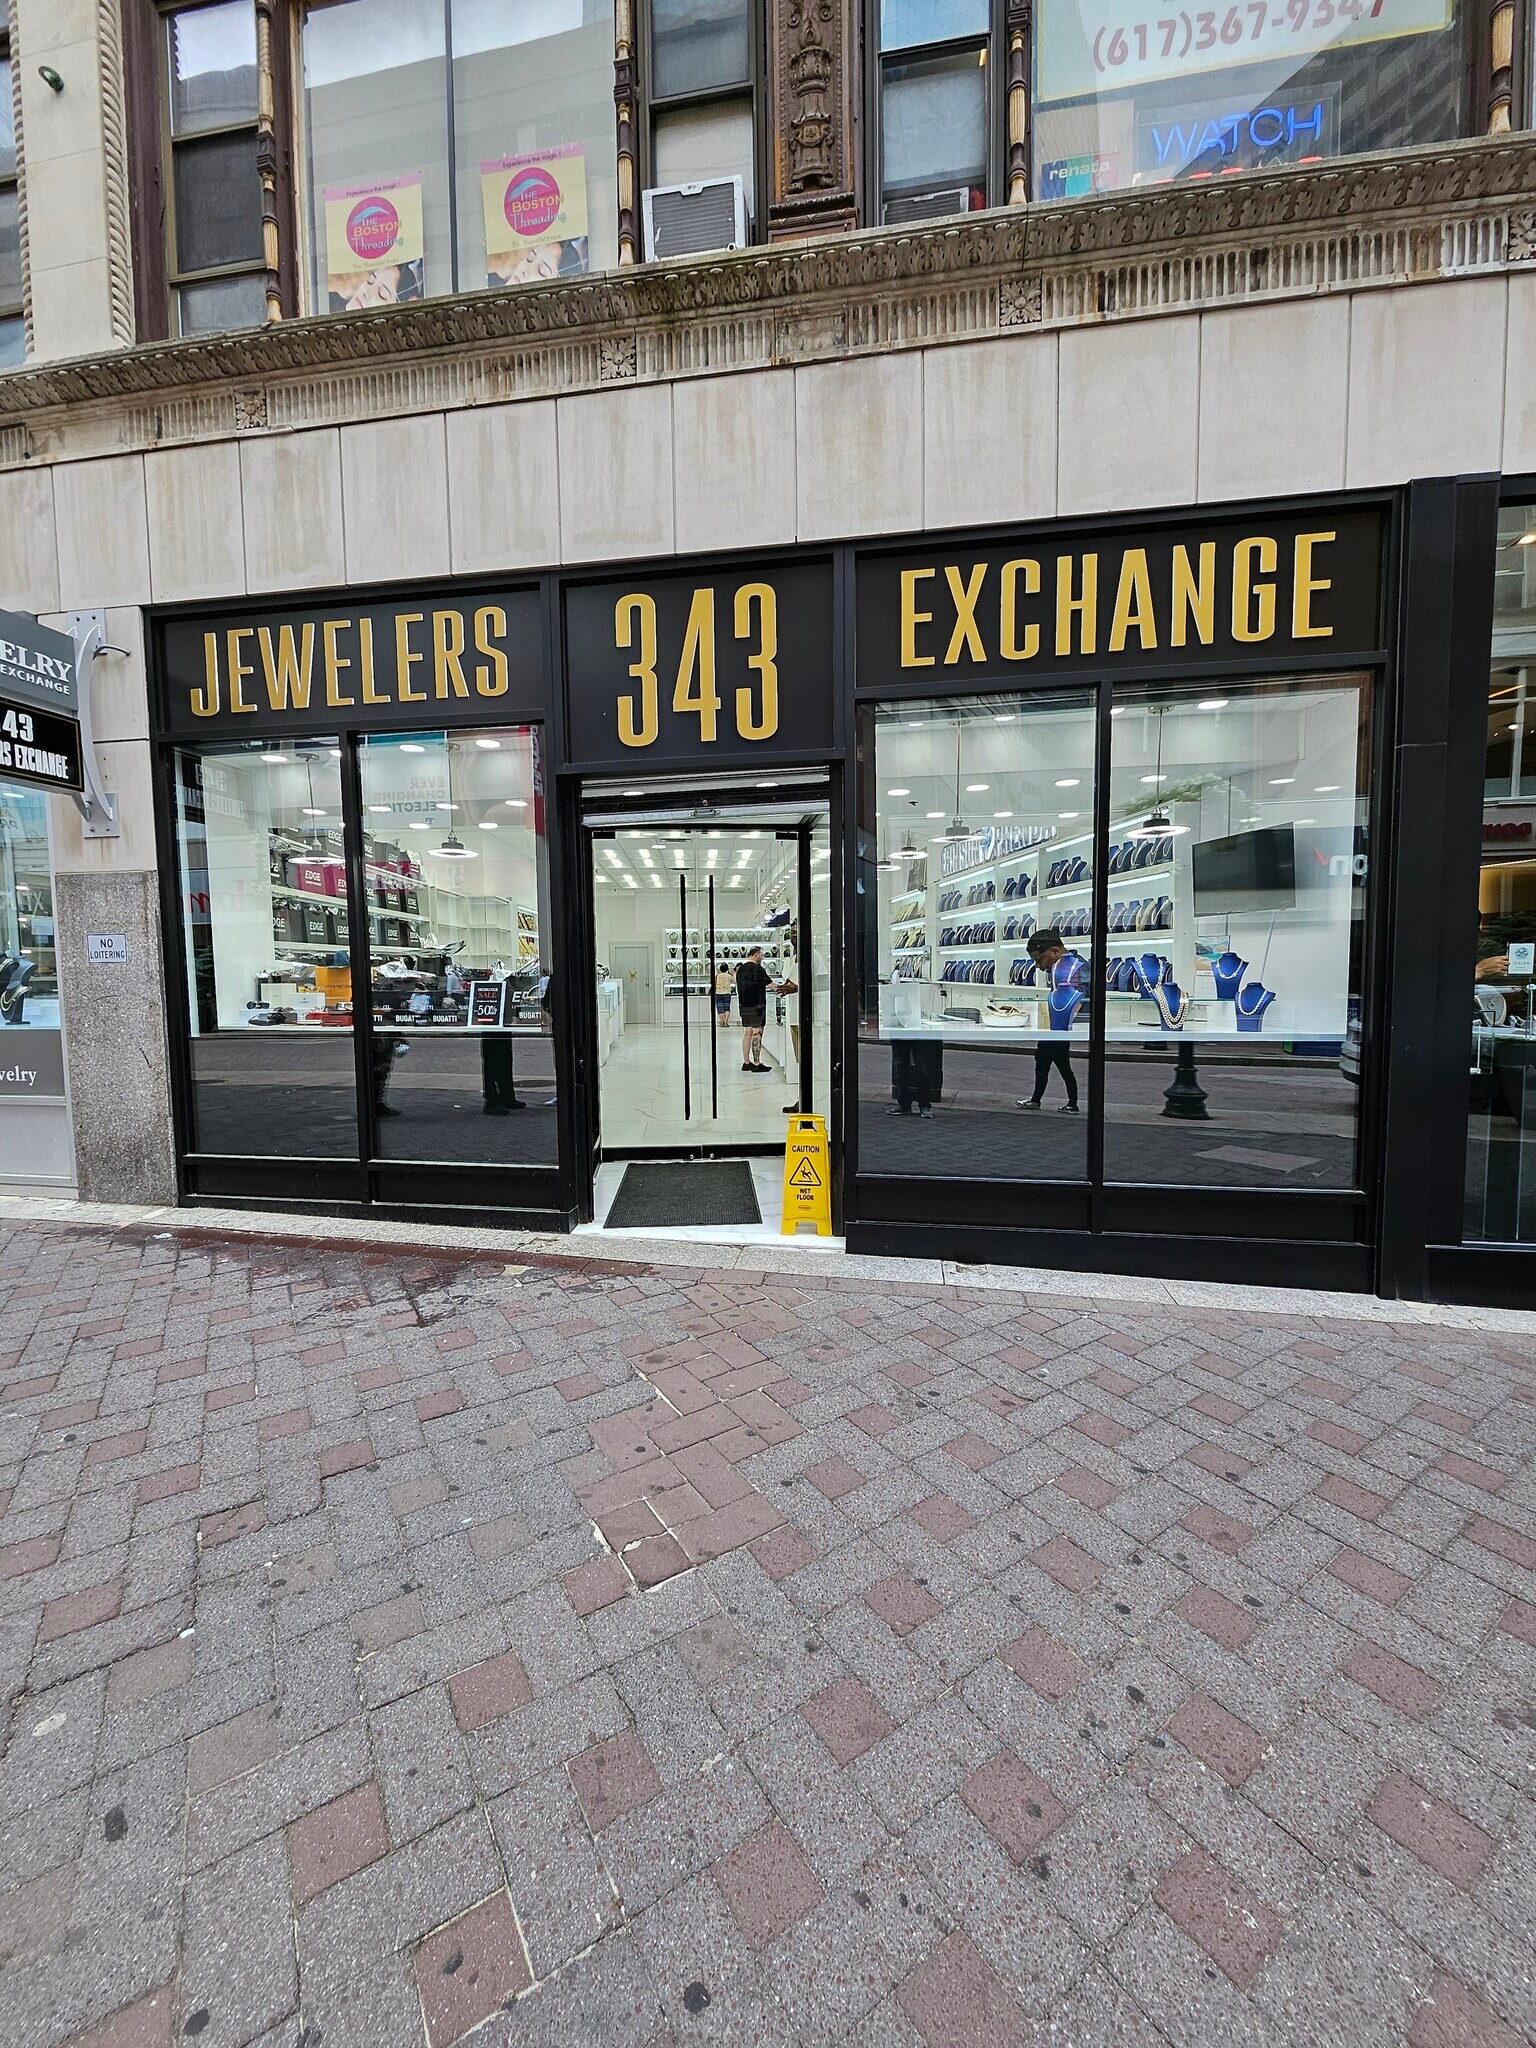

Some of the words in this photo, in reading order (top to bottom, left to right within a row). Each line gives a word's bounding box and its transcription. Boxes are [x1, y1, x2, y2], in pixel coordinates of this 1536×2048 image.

[1151, 103, 1323, 165] WATCH
[502, 157, 531, 168] Experience
[541, 152, 557, 161] magic
[1049, 159, 1110, 181] renata
[512, 194, 565, 213] BOSTON
[520, 191, 538, 201] THE
[362, 217, 378, 227] THE
[510, 207, 567, 230] Threading
[353, 220, 403, 238] BOSTON
[351, 232, 405, 254] Threading
[900, 531, 1337, 667] EXCHANGE
[0, 639, 73, 683] ELRY
[190, 606, 509, 717] JEWELERS
[615, 583, 779, 747] 343
[0, 664, 71, 696] EXCHANGE
[14, 743, 69, 780] EXCHANGE
[328, 829, 343, 842] EDGE
[304, 869, 321, 882] EDGE
[387, 892, 398, 902] EDGE
[407, 897, 417, 906] EDGE
[309, 921, 324, 932] EDGE
[387, 929, 398, 938] EDGE
[100, 938, 114, 949] NO
[90, 950, 126, 960] LOITERING
[432, 1014, 458, 1023] BUGATTI
[791, 1144, 820, 1154] CAUTION
